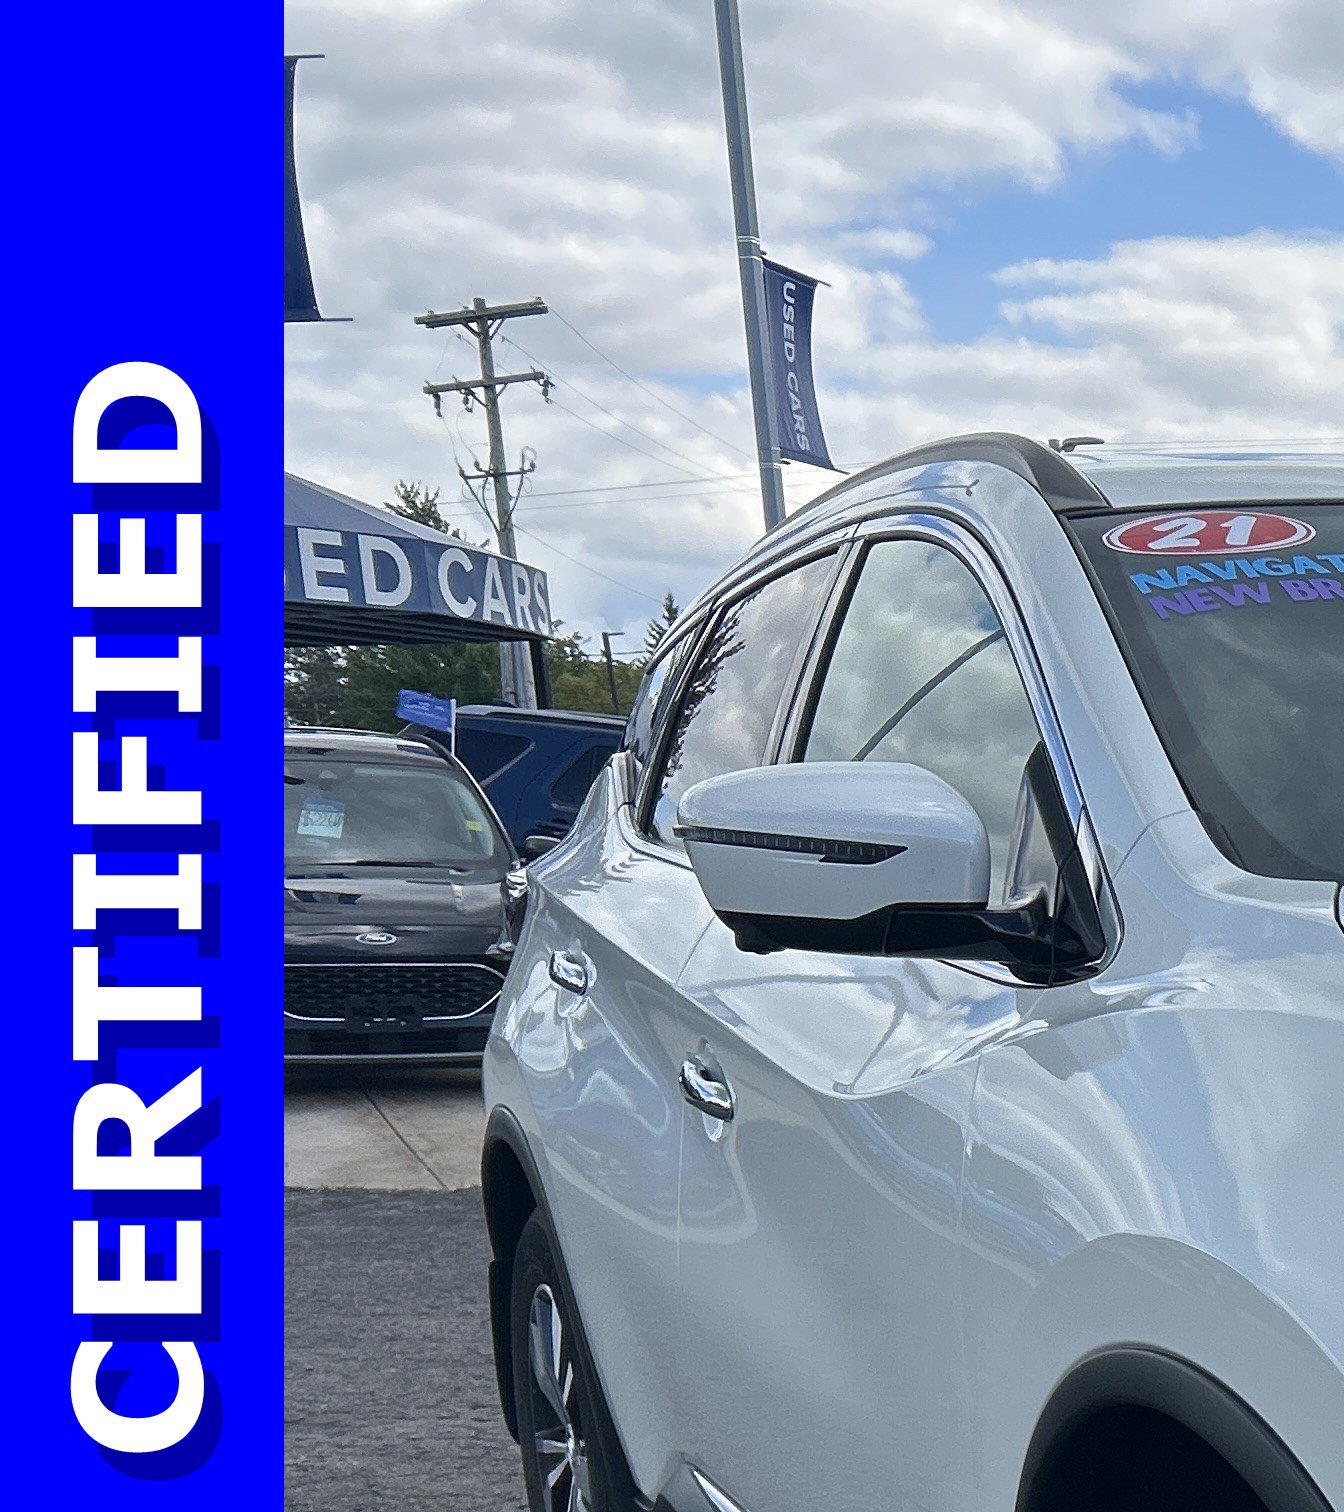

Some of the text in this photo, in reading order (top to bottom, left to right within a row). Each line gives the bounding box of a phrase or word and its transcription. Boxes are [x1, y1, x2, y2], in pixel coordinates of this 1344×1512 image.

[782, 281, 810, 450] USED CARS
[1148, 515, 1258, 550] 21
[284, 527, 550, 636] ED CARS
[1150, 582, 1272, 620] NEW
